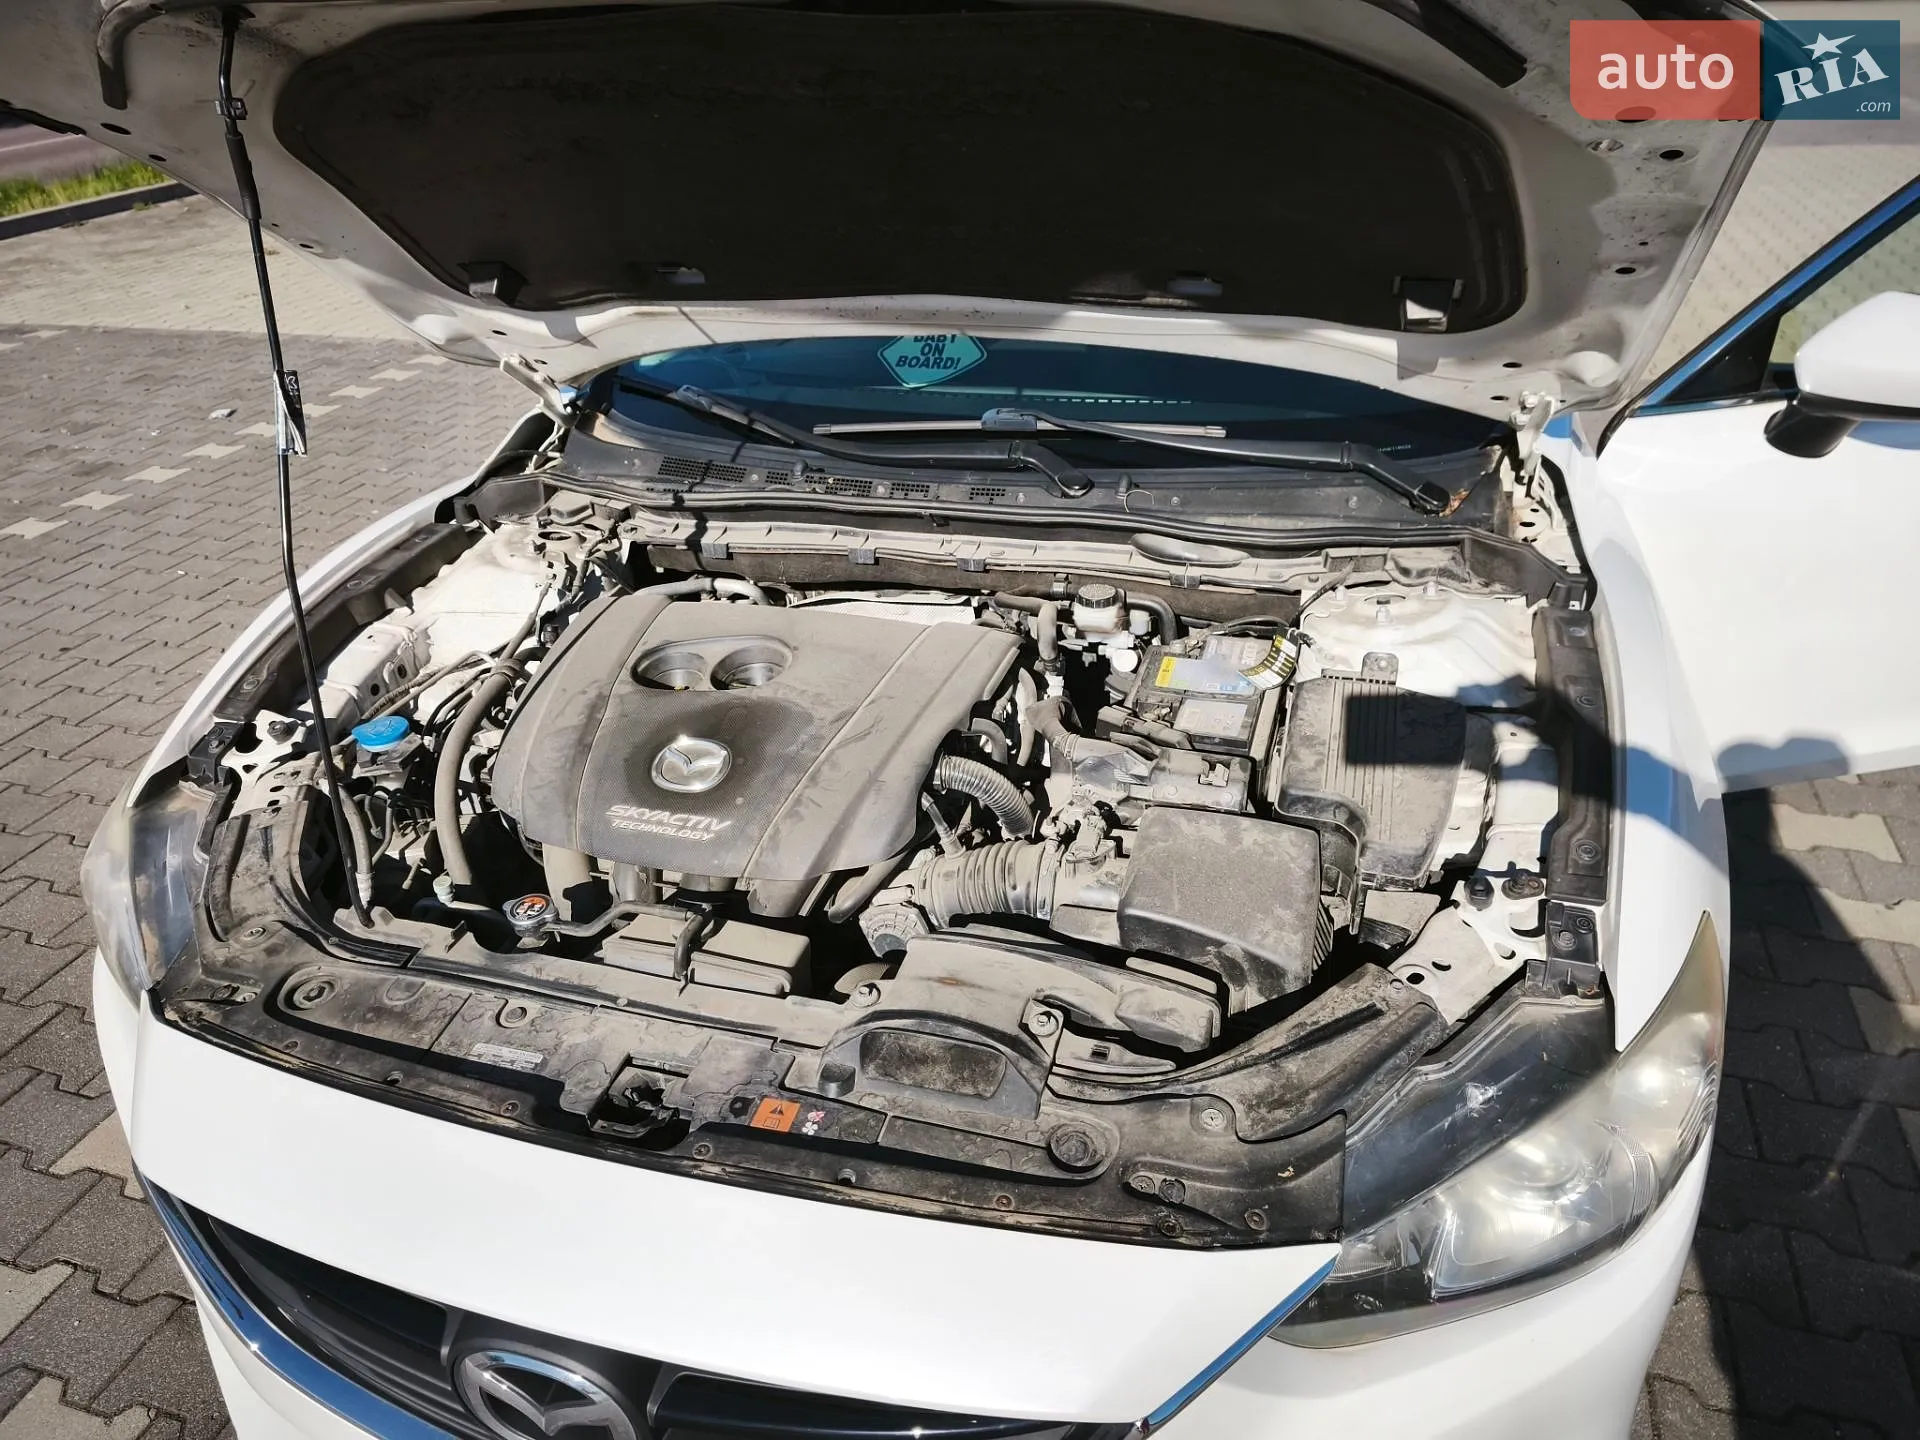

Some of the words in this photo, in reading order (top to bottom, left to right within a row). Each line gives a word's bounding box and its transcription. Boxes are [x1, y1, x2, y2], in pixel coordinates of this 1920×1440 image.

[920, 343, 946, 357] ON
[895, 355, 961, 370] BOARD!
[605, 804, 732, 831] SKYACTIV
[610, 819, 716, 842] TECHNOLOGY
